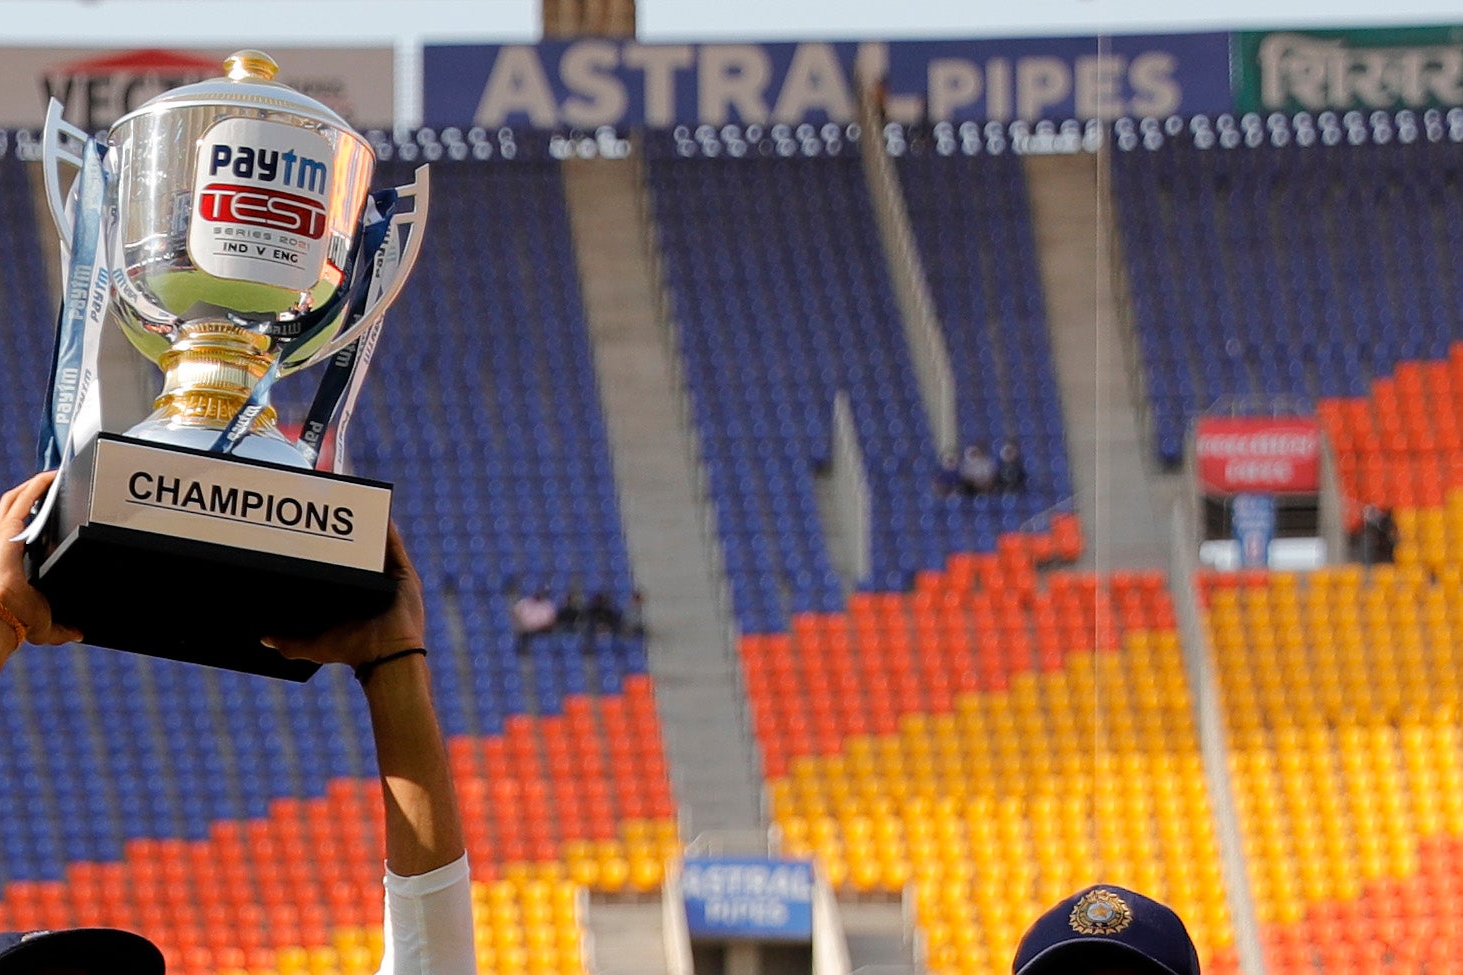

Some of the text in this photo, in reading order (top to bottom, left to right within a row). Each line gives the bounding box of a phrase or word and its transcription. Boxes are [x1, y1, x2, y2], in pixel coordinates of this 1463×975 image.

[474, 41, 1180, 127] ASTRAL PIPES
[209, 144, 327, 196] paytm
[200, 188, 327, 236] TEST
[212, 227, 311, 249] SERIES 2021
[223, 242, 299, 264] IND V ENG
[90, 267, 109, 324] paytm
[56, 367, 79, 424] paytm
[128, 470, 355, 538] CHAMPIONS
